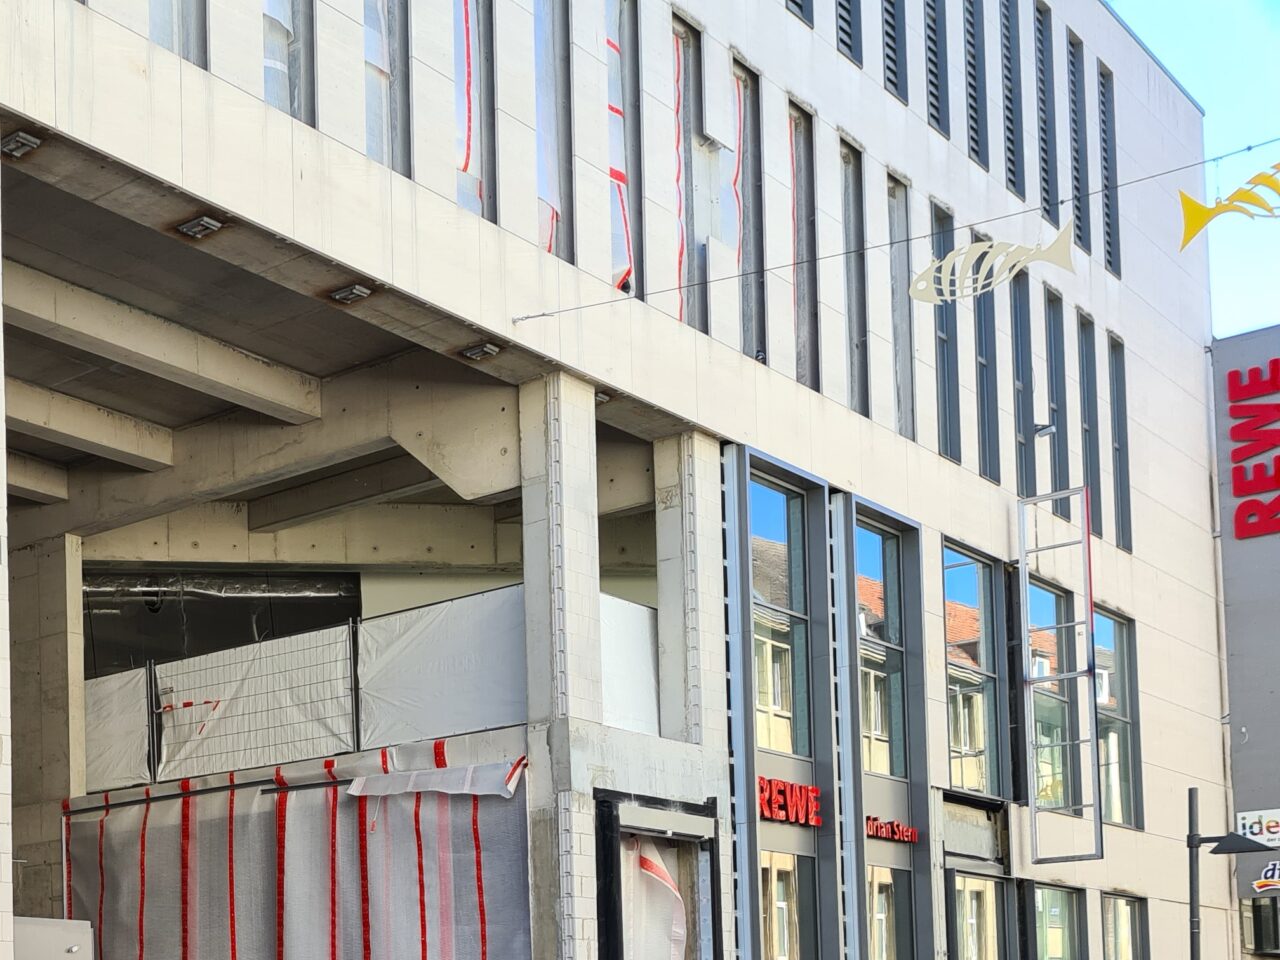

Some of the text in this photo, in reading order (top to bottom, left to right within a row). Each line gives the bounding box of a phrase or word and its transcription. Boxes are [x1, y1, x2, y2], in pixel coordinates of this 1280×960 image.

[1228, 358, 1280, 540] REWE
[758, 775, 822, 827] REWE
[893, 819, 918, 843] Stern
